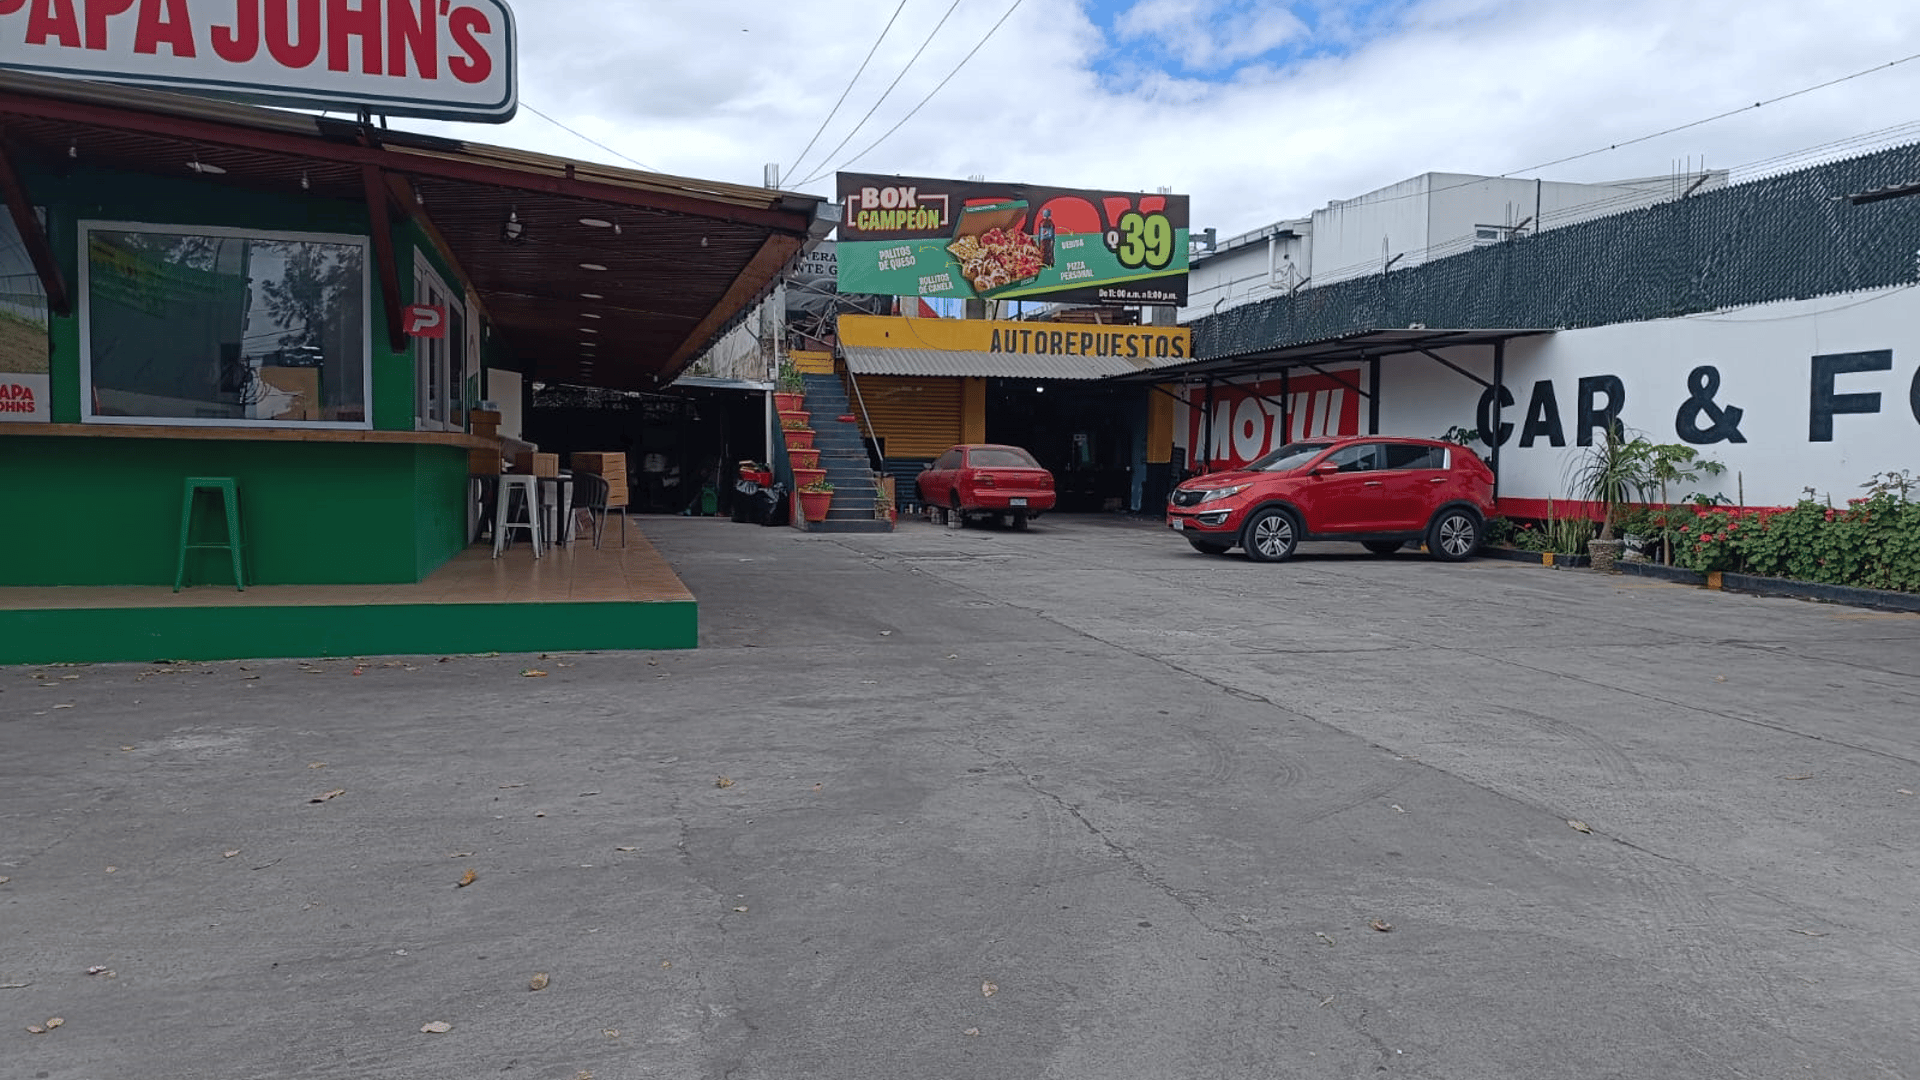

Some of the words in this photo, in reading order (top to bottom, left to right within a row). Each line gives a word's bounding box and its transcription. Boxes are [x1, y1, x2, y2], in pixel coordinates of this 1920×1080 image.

[0, 0, 196, 58] APA
[210, 0, 492, 84] JOHN'S
[861, 186, 917, 209] BOX
[857, 204, 940, 231] CAMPEÓN
[879, 245, 912, 260] PALITOS
[878, 260, 890, 271] DE
[890, 255, 915, 270] QUESO
[1066, 261, 1085, 271] PIZZA
[1061, 269, 1094, 281] PERSONAL
[1098, 288, 1108, 297] De
[990, 328, 1184, 358] AUTOREPUESTOS
[1476, 373, 1626, 449] CAR
[1675, 365, 1748, 444] &
[1809, 348, 1920, 443] F
